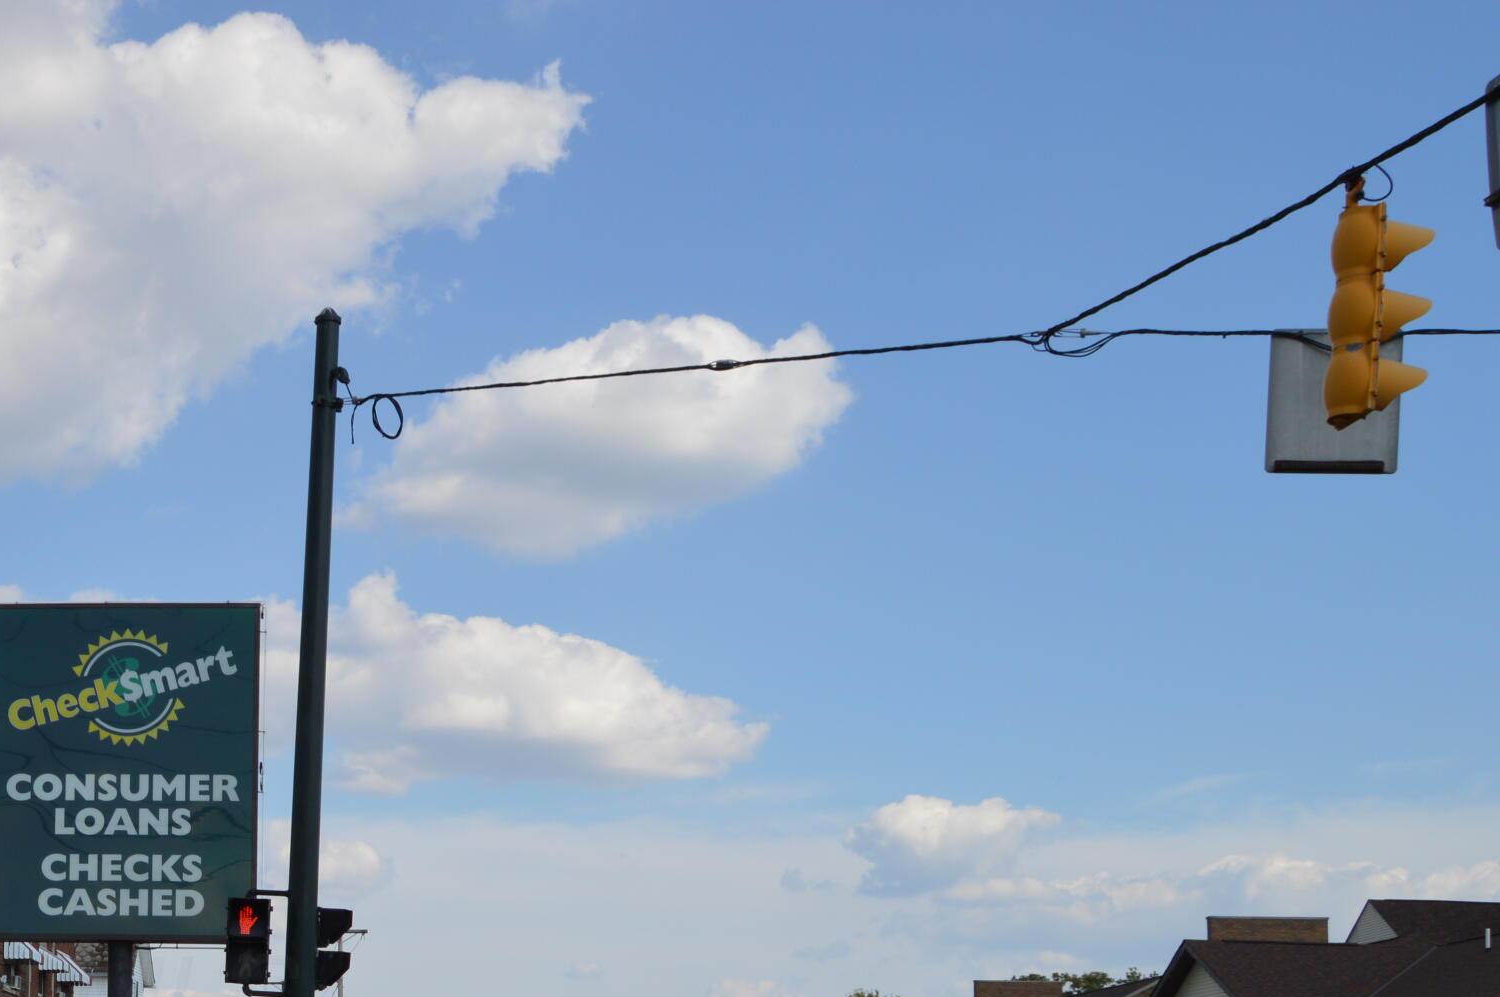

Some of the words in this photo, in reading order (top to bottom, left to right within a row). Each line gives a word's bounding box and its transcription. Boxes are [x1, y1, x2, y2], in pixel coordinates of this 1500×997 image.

[6, 773, 240, 802] CONSUMER
[53, 807, 192, 836] LOANS
[41, 853, 203, 882] CHECKS
[37, 888, 205, 917] CASHED
